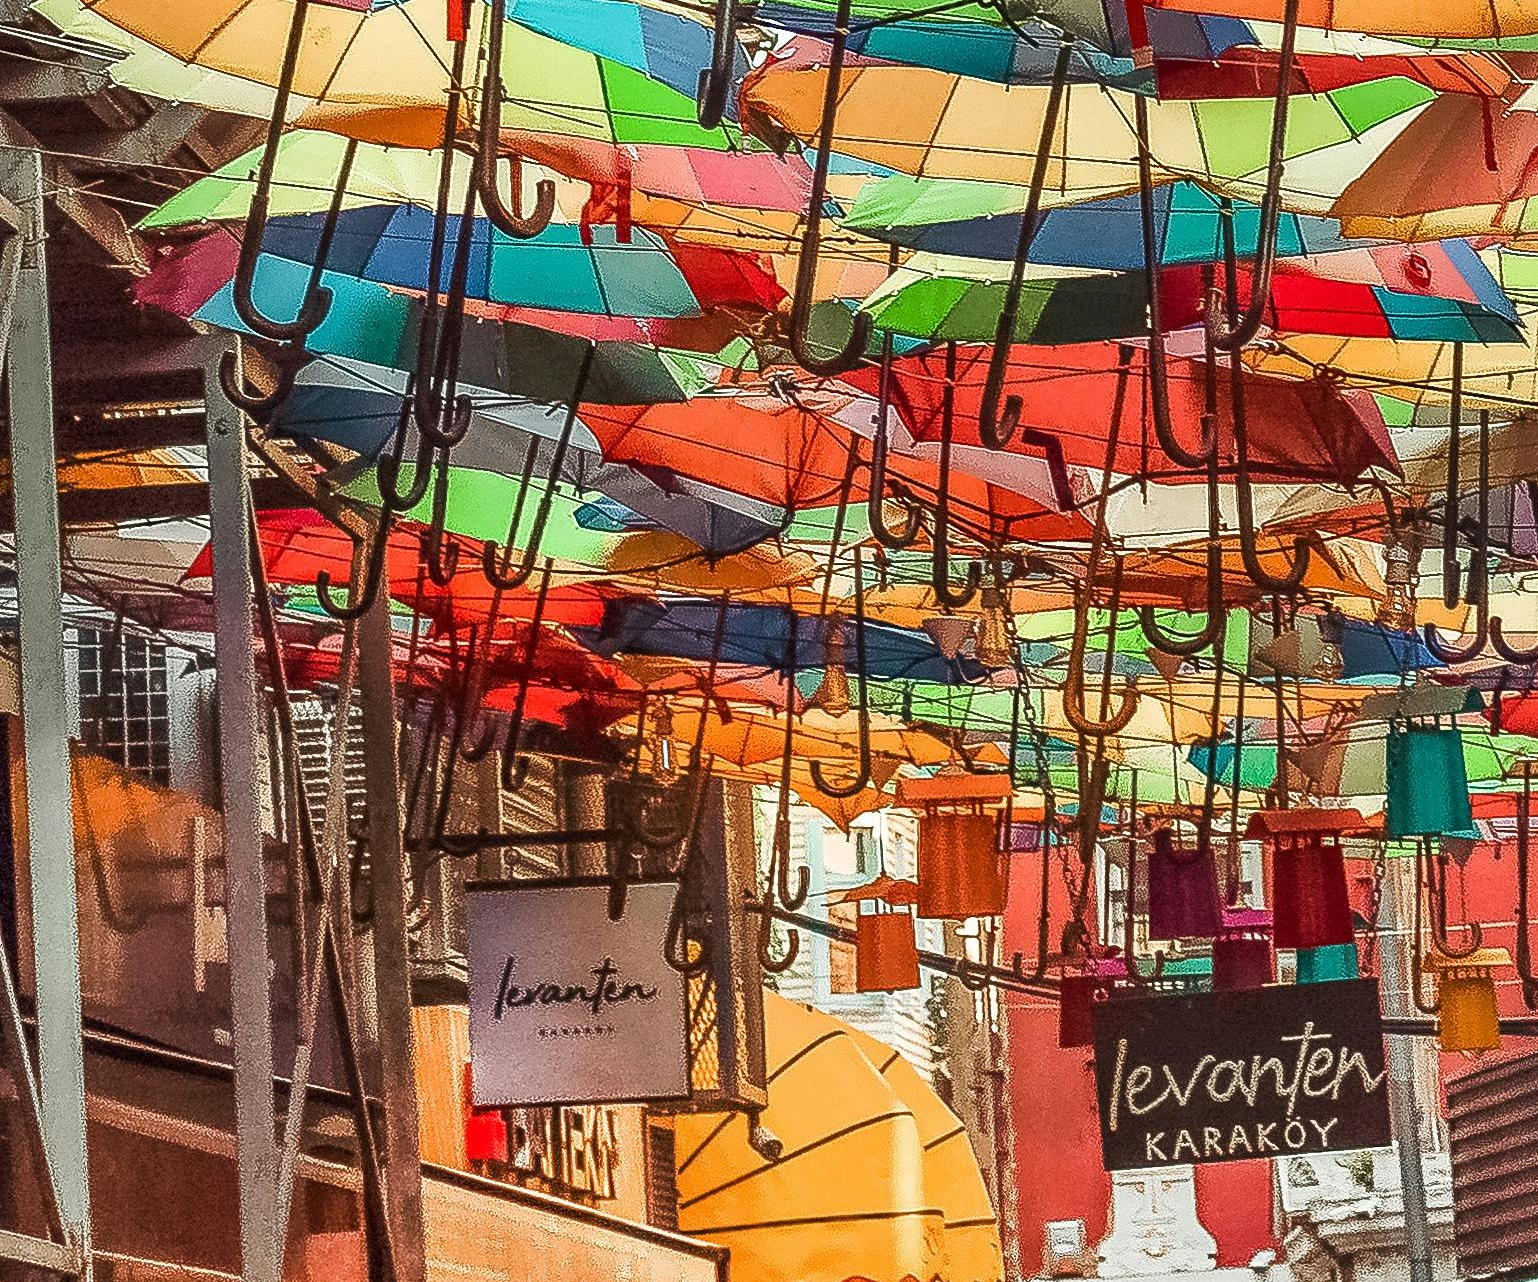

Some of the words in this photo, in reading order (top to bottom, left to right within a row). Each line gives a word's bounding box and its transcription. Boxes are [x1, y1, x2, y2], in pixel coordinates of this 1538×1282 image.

[493, 955, 659, 1022] levanten
[1109, 1021, 1389, 1132] levanten
[1145, 1116, 1339, 1162] KARAKÖY
